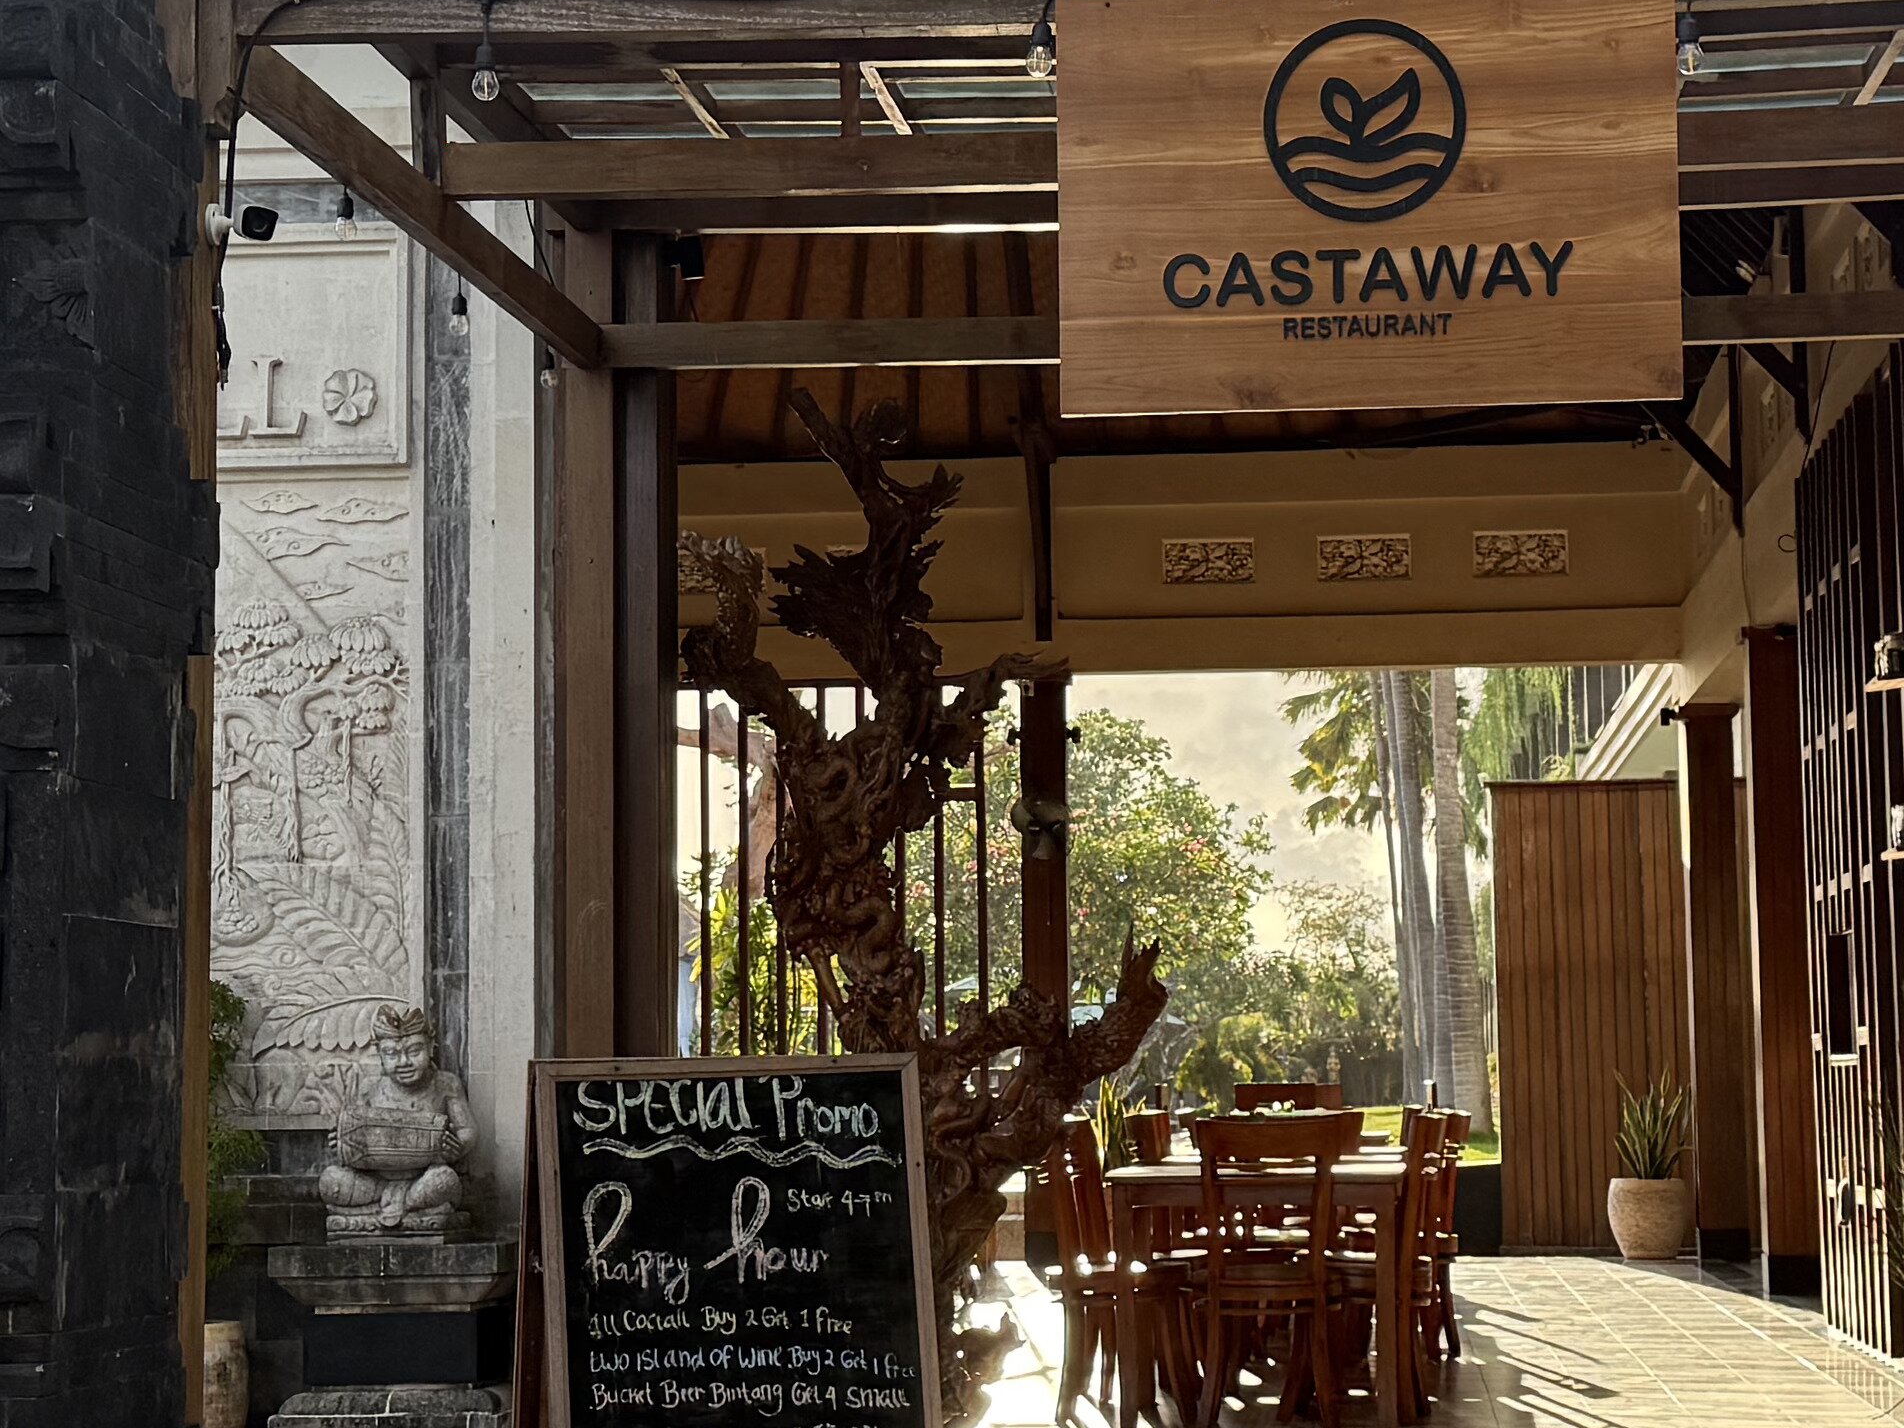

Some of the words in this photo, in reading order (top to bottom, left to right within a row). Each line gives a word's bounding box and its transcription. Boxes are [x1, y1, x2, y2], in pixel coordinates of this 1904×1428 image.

[1162, 239, 1575, 309] CASTAWAY
[1282, 312, 1453, 341] RESTAURANT
[703, 1176, 828, 1284] hour
[700, 1305, 737, 1335] Buy
[745, 1308, 759, 1327] 2
[799, 1308, 810, 1328] 1
[825, 1349, 835, 1367] 2
[873, 1357, 879, 1375] 1
[659, 1379, 706, 1408] Beer
[708, 1382, 783, 1417] Bintang
[825, 1385, 837, 1411] 4
